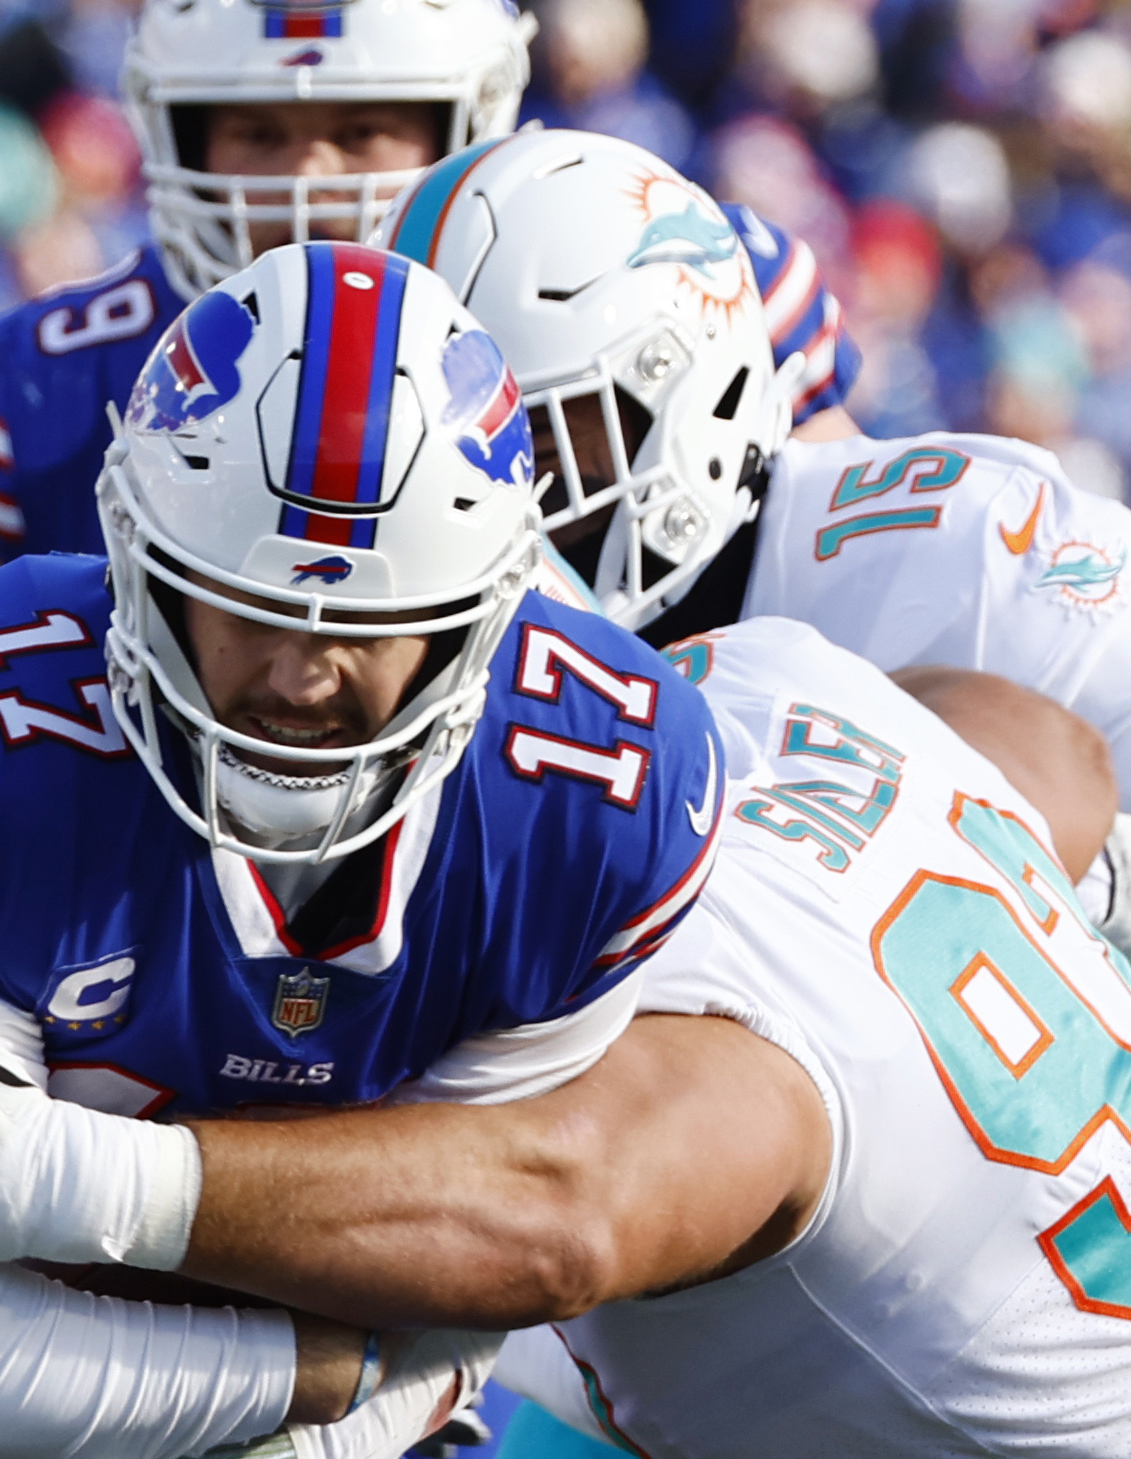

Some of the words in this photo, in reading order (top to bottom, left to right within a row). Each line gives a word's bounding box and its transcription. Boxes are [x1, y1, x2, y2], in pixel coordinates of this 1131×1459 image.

[814, 445, 972, 562] 15
[503, 621, 659, 813] 17
[49, 957, 136, 1020] C
[280, 1001, 319, 1026] NFL
[219, 1053, 335, 1086] BILLS
